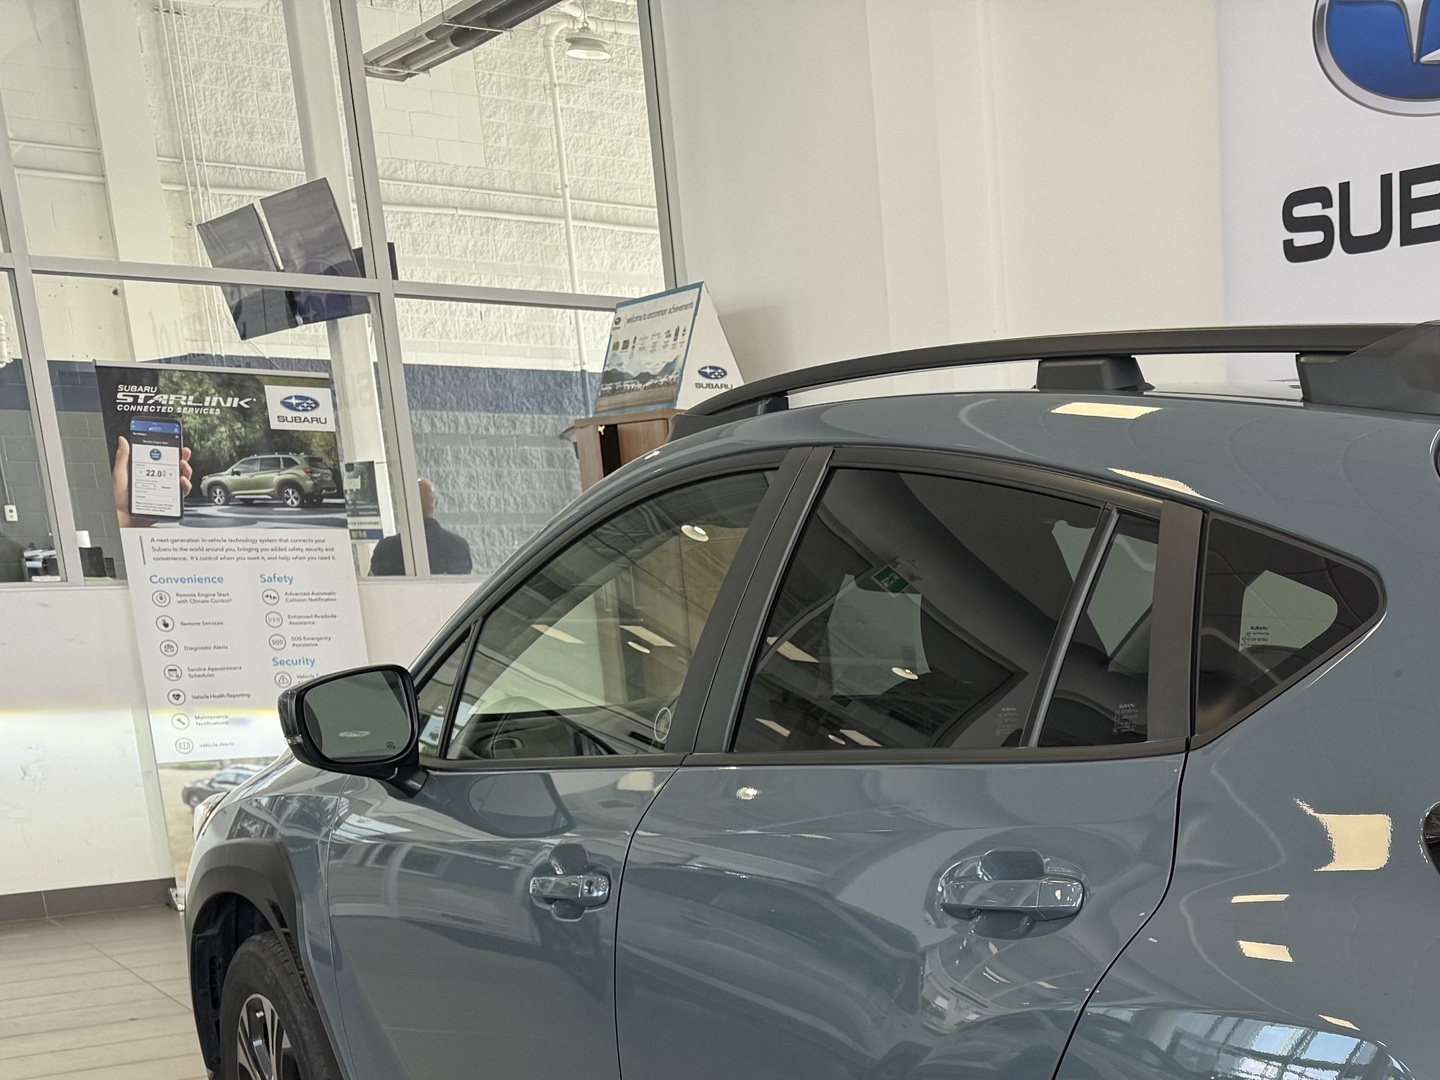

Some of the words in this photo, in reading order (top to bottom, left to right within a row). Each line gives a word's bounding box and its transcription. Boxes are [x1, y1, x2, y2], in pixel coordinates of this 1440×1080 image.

[117, 385, 157, 393] SUBARU
[116, 393, 252, 408] STARLINK
[117, 405, 173, 413] CONNECTED
[177, 406, 220, 415] SERVICES
[277, 416, 327, 424] SUBARU
[150, 574, 224, 584] Convenience
[259, 574, 293, 585] Safety
[272, 656, 315, 667] Security
